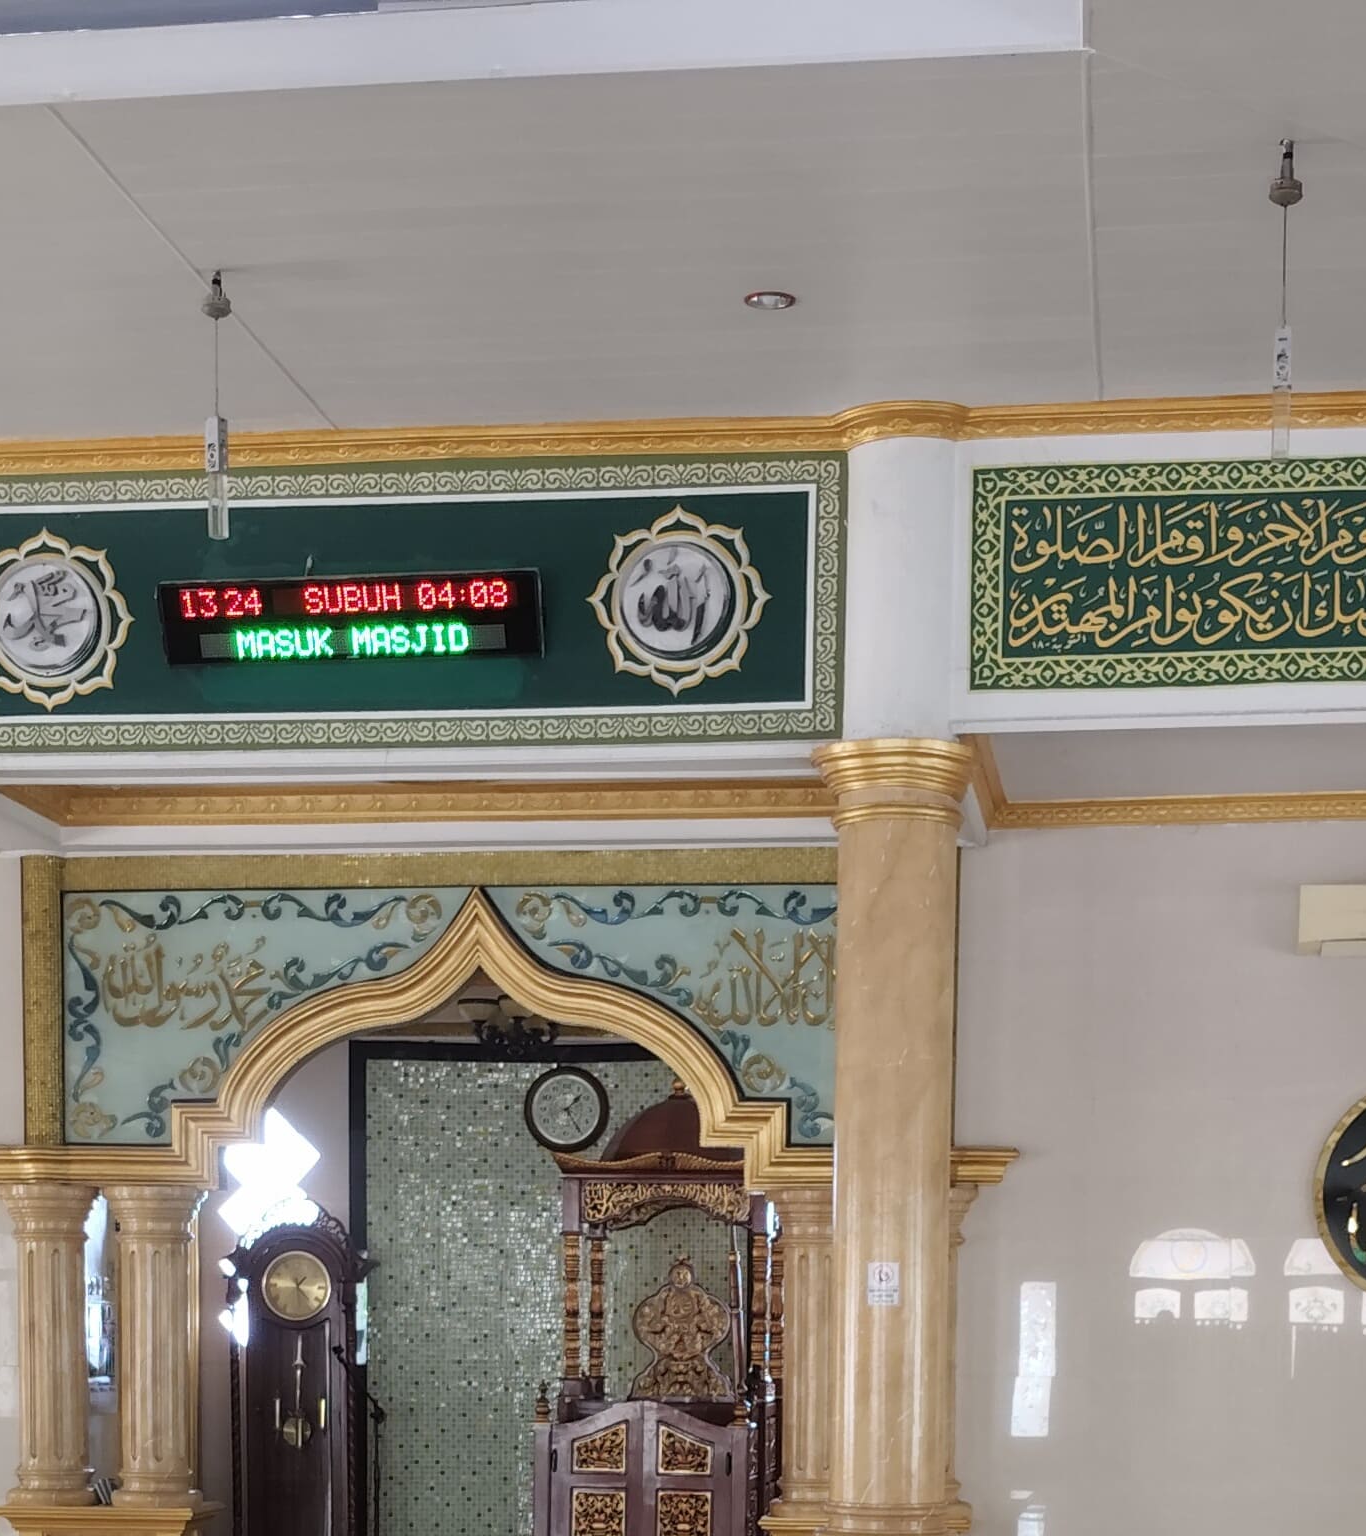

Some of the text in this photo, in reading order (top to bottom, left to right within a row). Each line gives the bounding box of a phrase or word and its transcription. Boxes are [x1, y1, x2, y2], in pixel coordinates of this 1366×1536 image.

[303, 582, 403, 615] SUBUH
[417, 579, 509, 612] 04:08
[234, 621, 470, 660] MASUK MASJID
